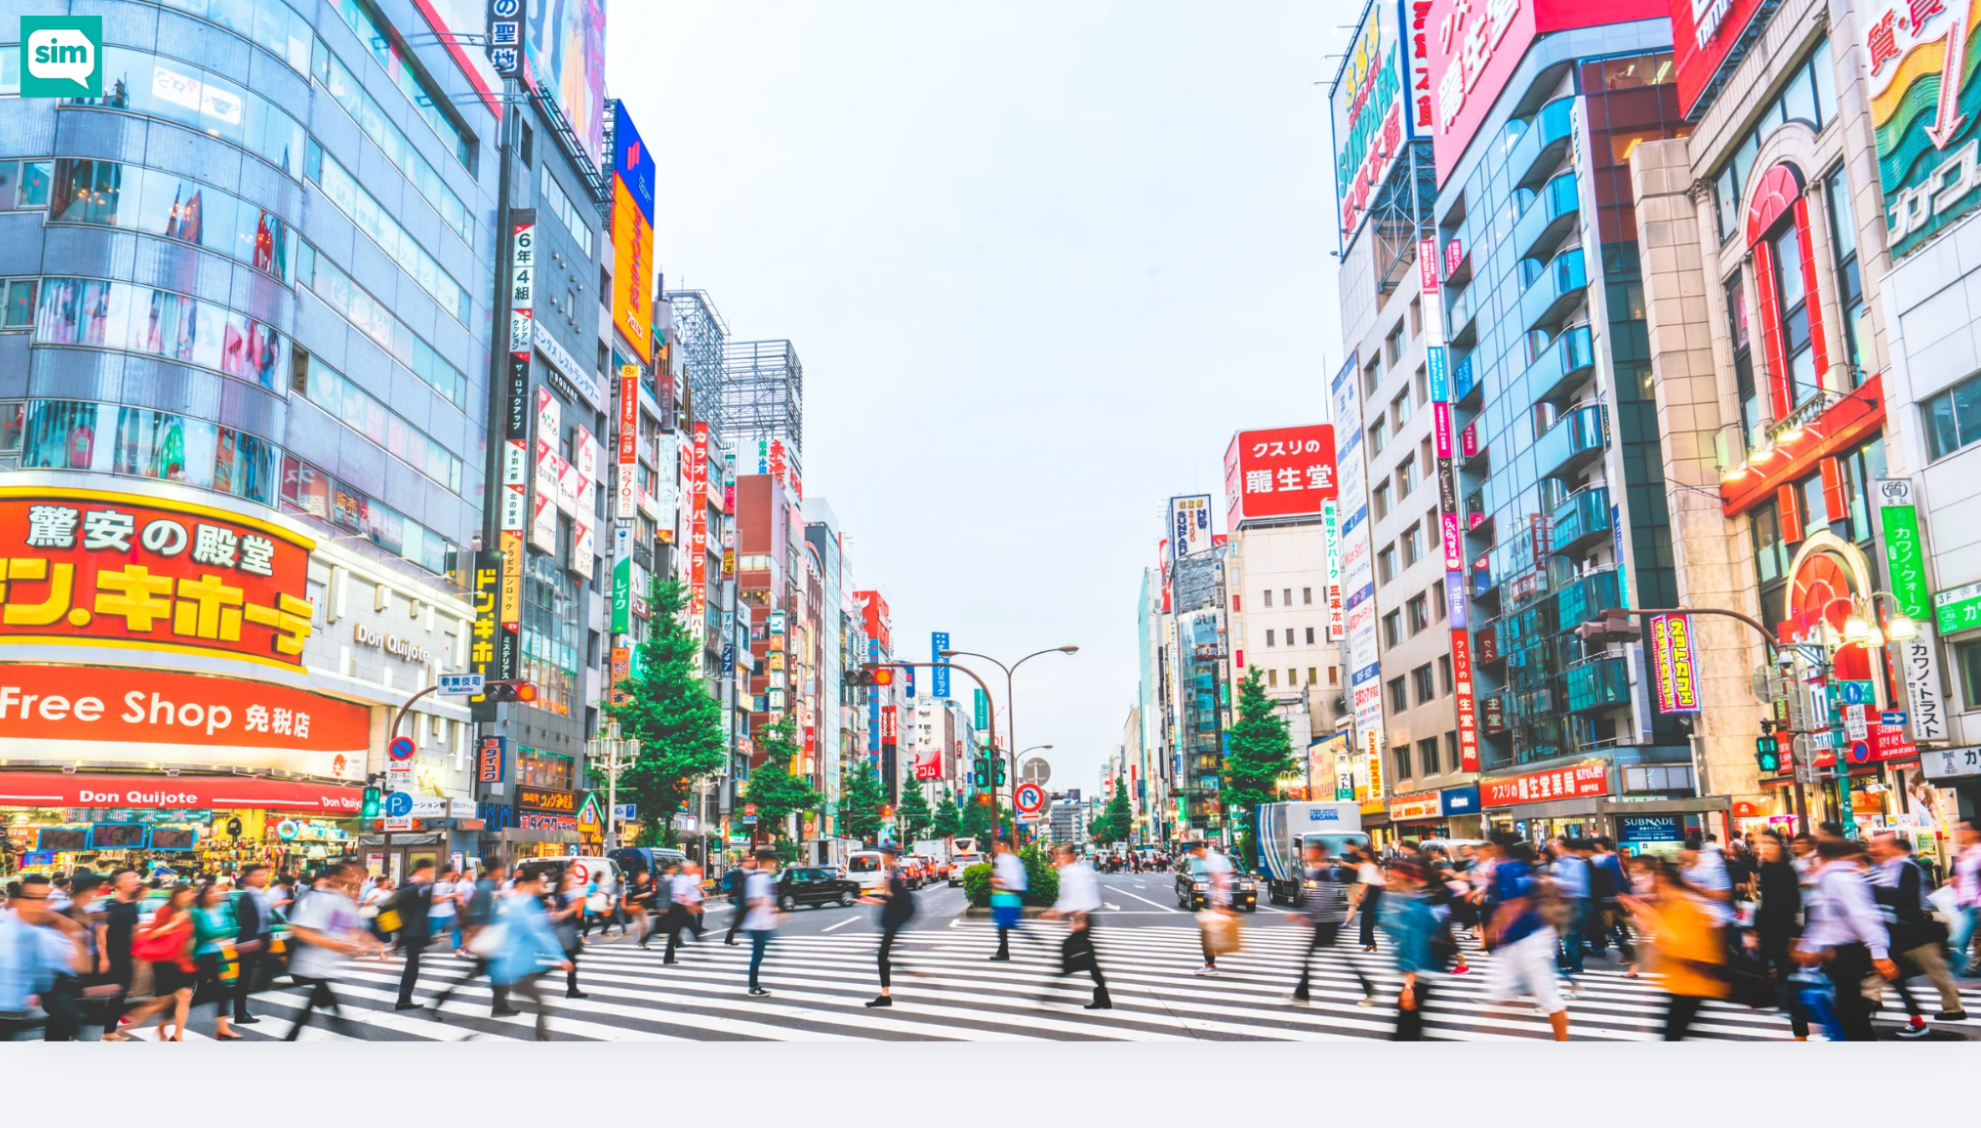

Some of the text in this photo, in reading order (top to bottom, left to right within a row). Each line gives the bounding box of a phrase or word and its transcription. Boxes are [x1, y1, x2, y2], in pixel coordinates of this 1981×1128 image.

[1339, 39, 1400, 199] SUNPARK
[1886, 138, 1981, 248] カワ
[514, 232, 531, 301] 6年4組
[629, 205, 643, 314] PROMISE
[512, 319, 521, 350] クッション
[624, 366, 636, 376] 8F
[512, 363, 523, 430] ザ・ロックアップ
[510, 449, 519, 480] 手羽一郎
[1252, 439, 1321, 459] クスリの
[1245, 463, 1333, 494] 龍生堂
[508, 493, 518, 525] 北の家族
[25, 505, 276, 576] 驚安の殿堂
[1324, 506, 1338, 579] 新宿サンパーク
[505, 541, 515, 611] アラビアンロック
[1893, 527, 1922, 617] カワノ・クォーク
[615, 578, 627, 610] レイク
[1329, 584, 1343, 636] 三平本館
[1938, 592, 1952, 605] 3F
[355, 624, 431, 663] Don Quijote
[502, 636, 511, 680] ミステリアス
[723, 645, 733, 671] 747
[1670, 620, 1694, 705] ネットカフェ
[441, 676, 481, 688] 歌舞伎町
[1456, 640, 1477, 759] クスリの龍生堂薬局
[1911, 645, 1939, 738] カワノ・トラスト
[0, 686, 232, 735] Free Shop
[244, 703, 311, 739] 免税店
[1368, 731, 1376, 756] GAME
[483, 749, 498, 782] ダイコク
[79, 790, 198, 806] Don Quijote
[321, 796, 340, 807] Don
[1492, 771, 1575, 800] クスリの龍生堂薬局
[1624, 817, 1676, 826] SUBNADE
